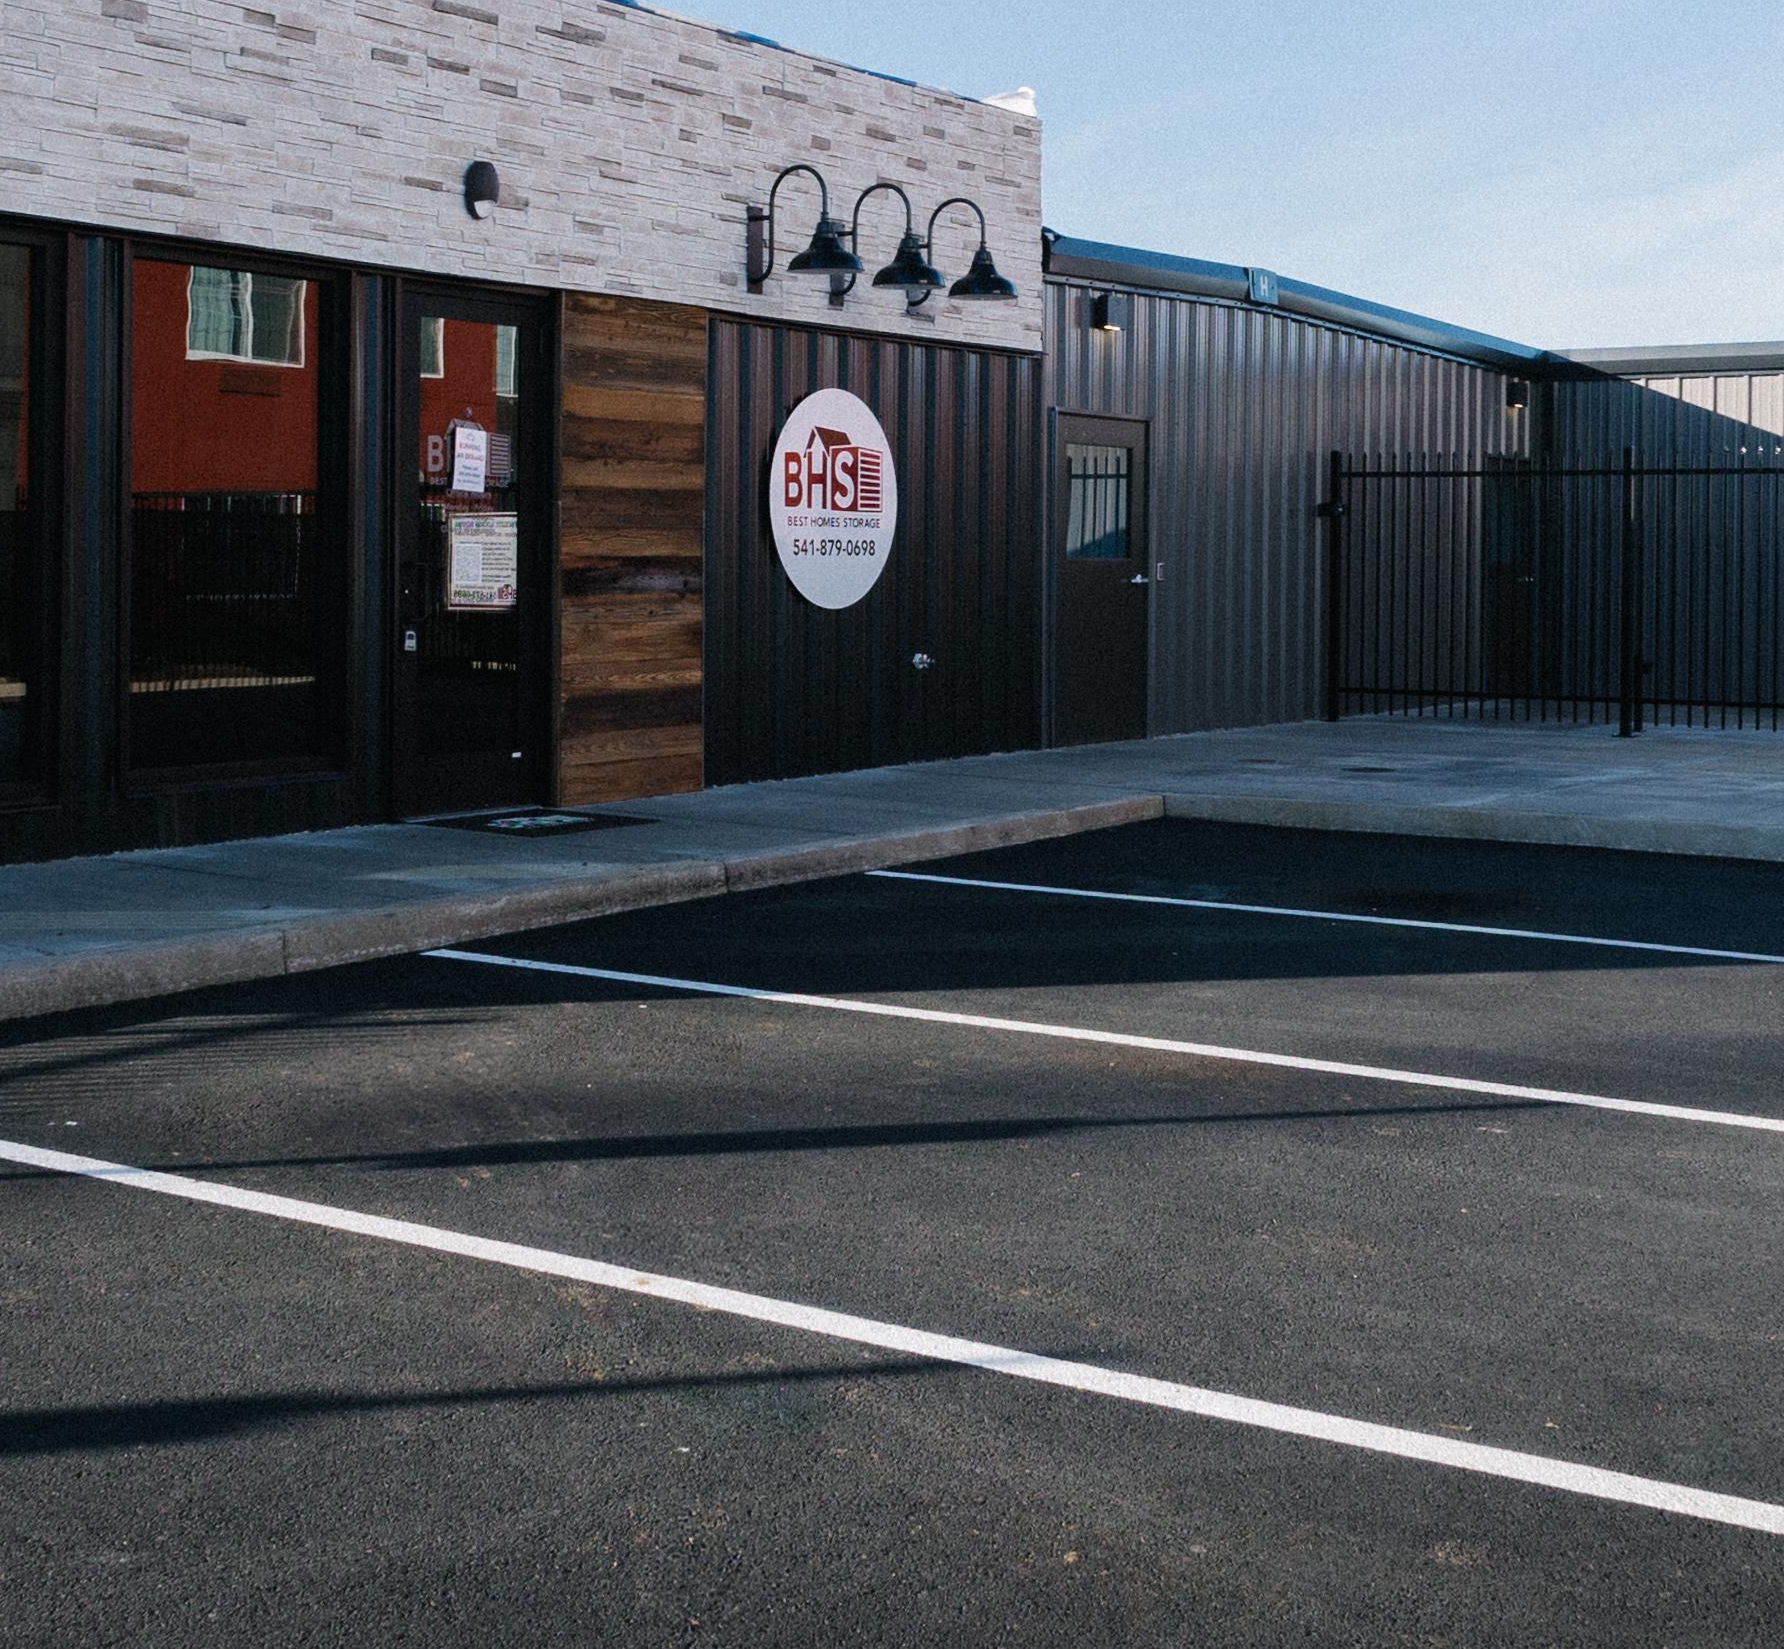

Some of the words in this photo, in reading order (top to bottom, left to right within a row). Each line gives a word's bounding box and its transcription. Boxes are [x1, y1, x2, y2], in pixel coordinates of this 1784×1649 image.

[1259, 275, 1269, 297] H
[784, 450, 857, 511] BHS
[787, 515, 809, 527] BEST
[810, 516, 841, 528] HOMES
[843, 517, 881, 529] STORAGE
[792, 538, 876, 557] 541-879-0698
